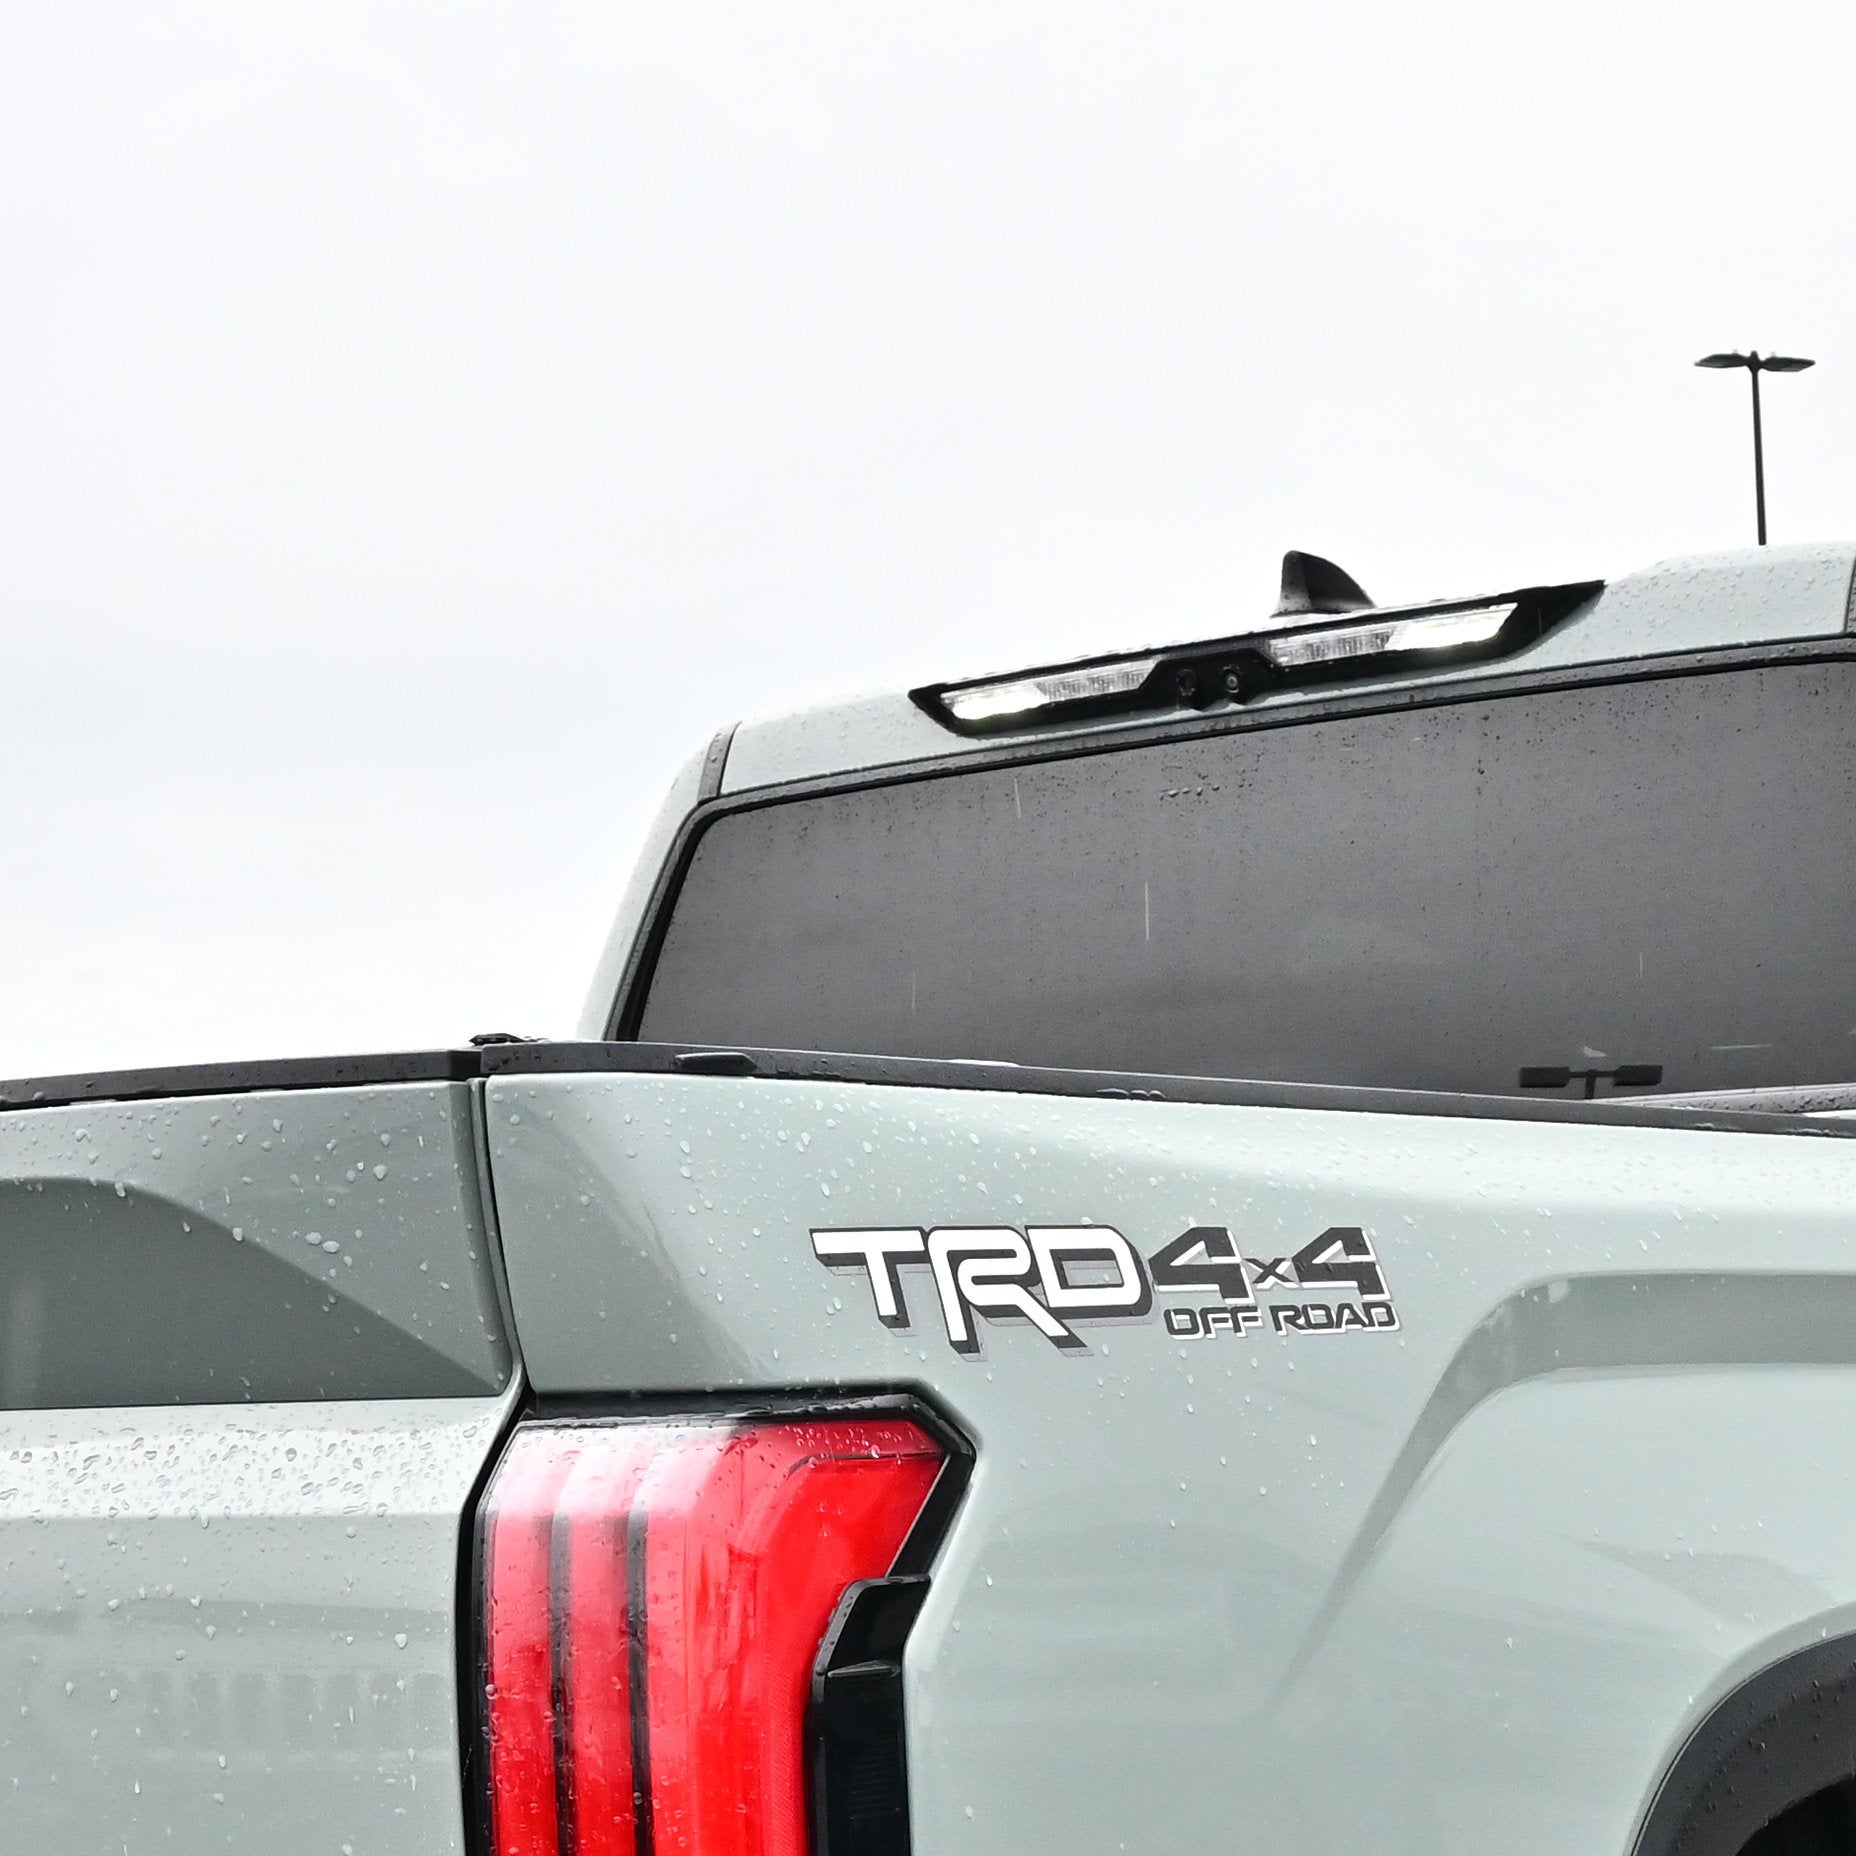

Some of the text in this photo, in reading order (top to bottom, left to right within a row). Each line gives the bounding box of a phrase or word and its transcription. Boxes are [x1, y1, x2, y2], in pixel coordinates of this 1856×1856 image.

[809, 1225, 1393, 1358] TRD 4x4
[1162, 1301, 1400, 1341] OFF ROAD
